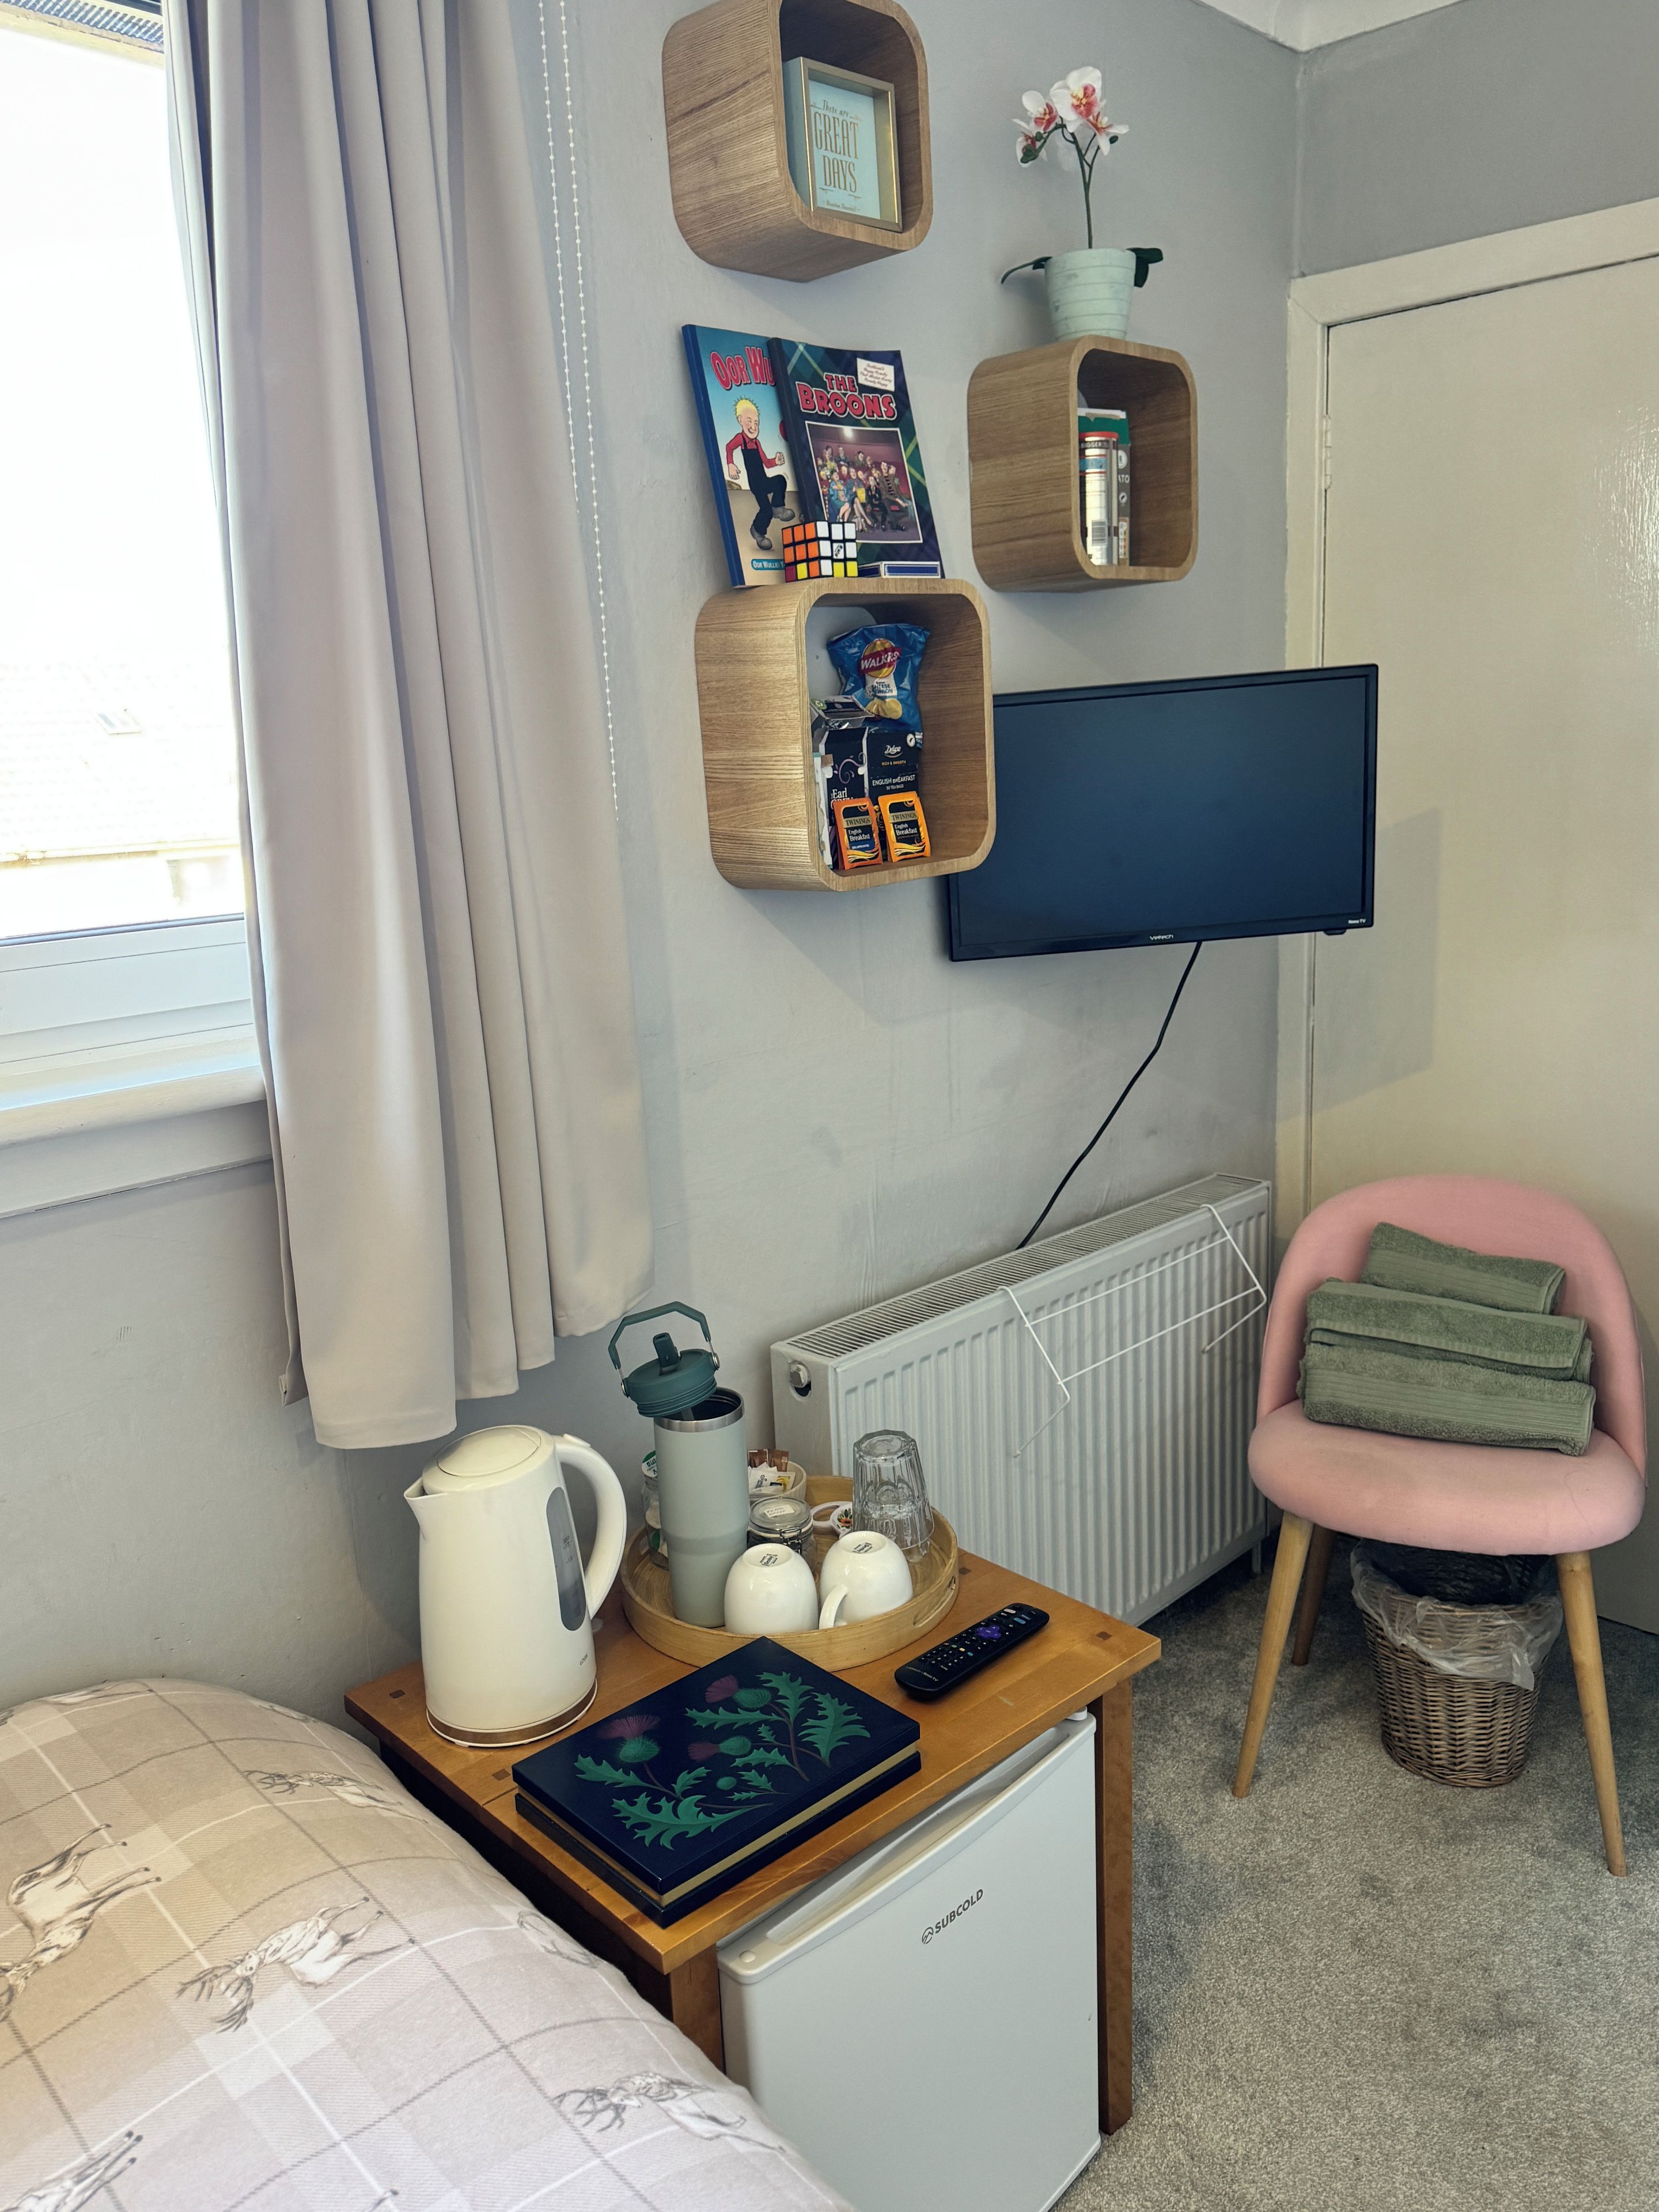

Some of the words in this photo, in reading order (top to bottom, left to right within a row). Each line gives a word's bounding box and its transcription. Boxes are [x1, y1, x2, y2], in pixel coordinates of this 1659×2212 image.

[813, 111, 859, 160] GREAT
[822, 155, 857, 192] DAYS
[710, 351, 751, 391] OOR
[824, 372, 859, 394] THE
[796, 381, 897, 421] BROONS
[872, 778, 892, 786] ENGLISH
[892, 774, 915, 783] BREAKFAST
[832, 787, 847, 799] Earl
[846, 817, 871, 826] TWININGS
[892, 812, 917, 821] TWININGS
[850, 834, 870, 842] Breakfast
[896, 828, 918, 836] Breakfast
[935, 1889, 983, 1934] SUBCOLD
